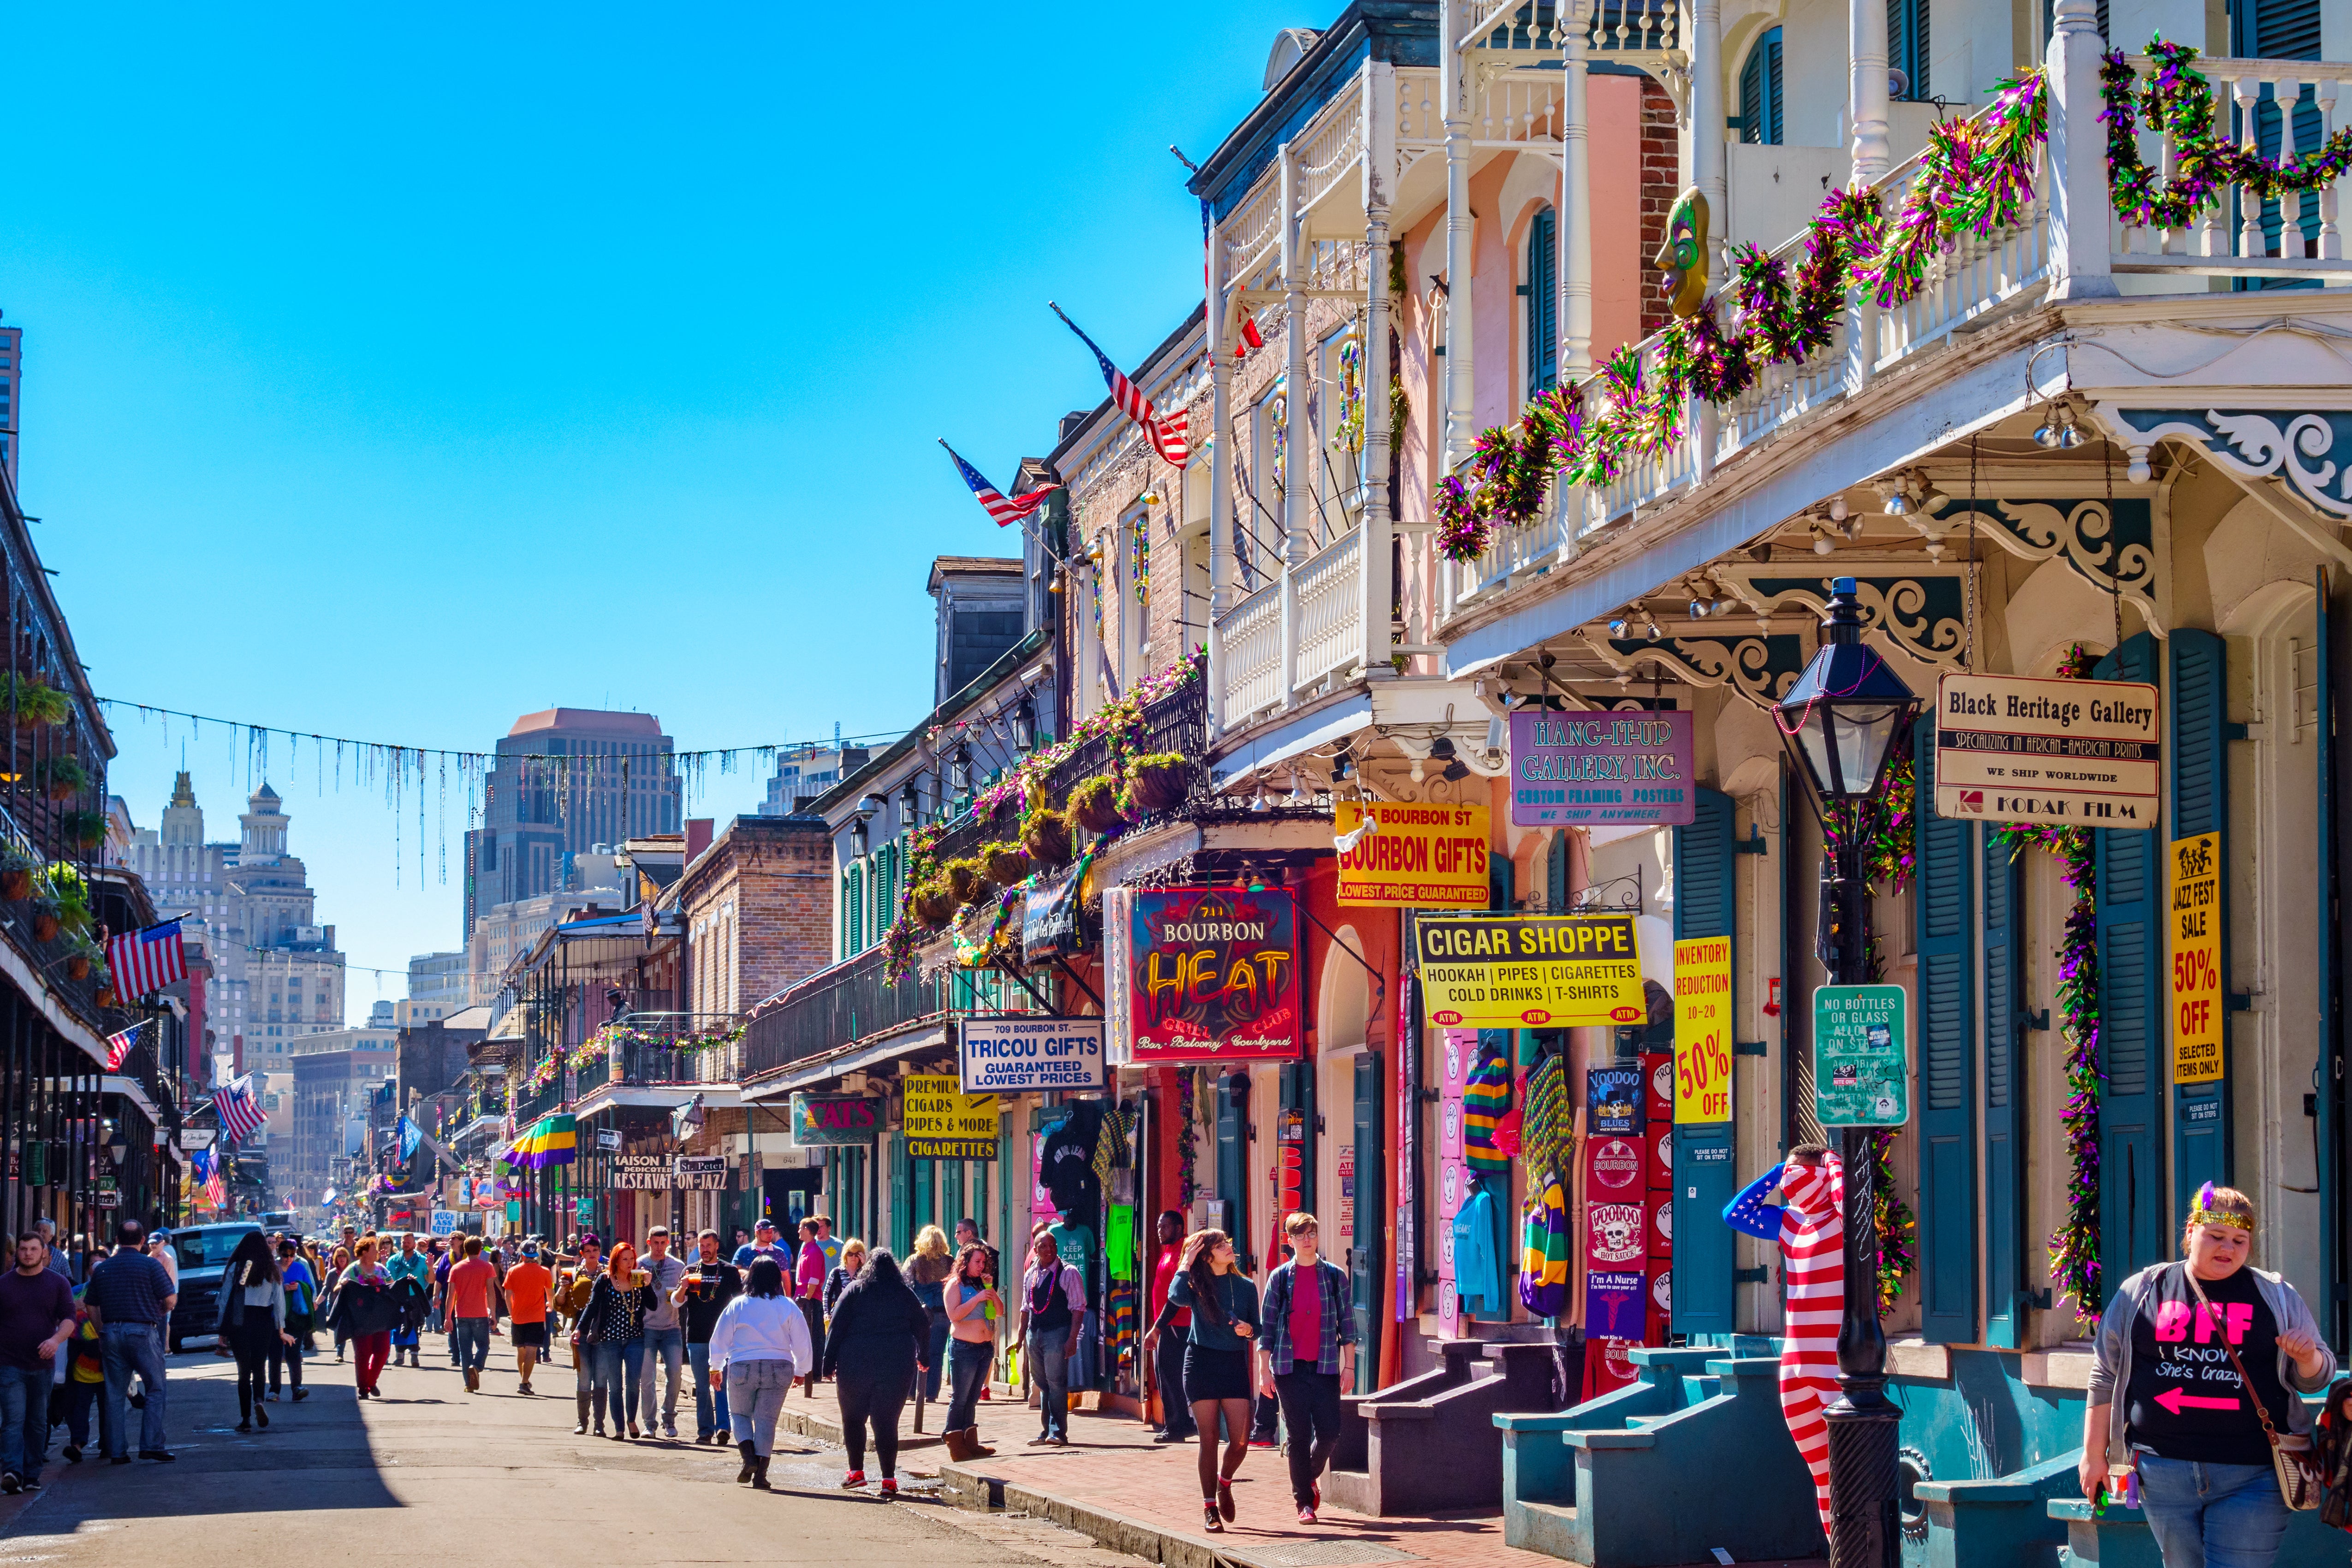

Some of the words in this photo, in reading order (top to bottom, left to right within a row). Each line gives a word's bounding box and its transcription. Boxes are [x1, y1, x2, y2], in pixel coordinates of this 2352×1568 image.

[1949, 692, 1997, 716] Black
[2007, 695, 2080, 727] Heritage
[2091, 700, 2152, 731] Gallery
[1534, 720, 1672, 746] HANG-IT-UP
[1956, 732, 2008, 751] SPECIALIZING
[2014, 736, 2021, 751] IN
[2027, 737, 2109, 757] AFRICAN-AMERICAN
[2115, 742, 2142, 758] PRINTS
[1520, 754, 1629, 783] GALLERY,
[1633, 754, 1681, 781] INC.
[1987, 767, 2004, 776] WE
[2012, 769, 2039, 778] SHIP
[2046, 771, 2118, 782] WORLDWIDE
[1518, 790, 1564, 804] CUSTOM
[1569, 790, 1621, 803] FRAMING
[1634, 789, 1683, 802] POSTERS
[1541, 811, 1556, 820] WE
[1565, 810, 1591, 819] SHIP
[1600, 809, 1661, 819] ANYWHERE
[1997, 797, 2071, 815] KODAK
[2084, 802, 2136, 819] FILM
[1382, 809, 1450, 825] BOURBON
[1455, 811, 1472, 826] ST
[1435, 837, 1485, 874] GIFTS
[1340, 884, 1380, 897] LOWEST
[1385, 885, 1415, 899] PRICE
[1418, 887, 1486, 902] GUARANTEED
[2174, 884, 2191, 912] JAZZ
[2194, 879, 2215, 906] FEST
[1200, 907, 1224, 917] 711
[1163, 922, 1264, 942] BOURBON
[2181, 911, 2206, 940] SALE
[1427, 929, 1511, 956] CIGAR
[1520, 926, 1629, 954] SHOPPE
[1676, 943, 1727, 965] INVENTORY
[1428, 968, 1485, 982] HOOKAH
[1499, 968, 1538, 981] PIPES
[1551, 965, 1636, 980] CIGARETTES
[2174, 947, 2216, 993] 50%
[1147, 950, 1289, 1023] HEAT
[1449, 988, 1485, 1002] COLD
[1491, 987, 1542, 1002] DRINKS
[1558, 985, 1619, 1000] T-SHIRTS
[1676, 974, 1728, 996] REDUCTION
[1688, 1005, 1715, 1019] 10-20
[1825, 999, 1840, 1010] NO
[1846, 998, 1895, 1009] BOTTLES
[1163, 1018, 1211, 1039] GRILL
[1252, 1008, 1291, 1033] CLUB
[1438, 1013, 1458, 1023] ATM
[1526, 1011, 1546, 1022] ATM
[1616, 1009, 1635, 1020] ATM
[1832, 1012, 1845, 1023] OR
[1852, 1012, 1889, 1023] GLASS
[2180, 999, 2209, 1036] OFF
[1014, 1024, 1055, 1033] BOURBON
[1058, 1024, 1071, 1032] ST.
[968, 1039, 1037, 1058] TRICOU
[1045, 1037, 1098, 1056] GIFTS
[1136, 1036, 1163, 1050] Bar
[1170, 1035, 1224, 1051] Balcony
[1230, 1035, 1292, 1050] Courtyard
[1829, 1039, 1843, 1049] ON
[2179, 1043, 2215, 1061] SELECTED
[985, 1062, 1081, 1074] GUARANTEED
[1452, 1063, 1455, 1074] 2
[1677, 1030, 1728, 1100] 50%
[2177, 1063, 2197, 1078] ITEMS
[2199, 1059, 2219, 1075] ONLY
[907, 1080, 960, 1094] PREMIUM
[976, 1074, 1033, 1086] LOWEST
[1039, 1072, 1092, 1083] PRICES
[1589, 1071, 1639, 1087] VOODOO
[907, 1099, 952, 1112] CIGARS
[1703, 1093, 1728, 1116] OFF
[808, 1101, 874, 1129] CATS
[906, 1117, 942, 1132] PIPES
[947, 1120, 954, 1131] &
[958, 1119, 993, 1132] MORE
[909, 1141, 994, 1157] CIGARETTES
[1594, 1160, 1638, 1170] BOURBON
[608, 1173, 693, 1189] RESERVATON
[699, 1170, 728, 1189] JAZZ
[1592, 1206, 1640, 1226] VOODOO
[433, 1226, 456, 1234] BEERS
[1447, 1245, 1451, 1257] 2
[1615, 1251, 1634, 1260] SAUCE
[1592, 1275, 1604, 1283] I'm
[1606, 1275, 1612, 1283] A
[1615, 1275, 1638, 1284] Nurse
[1447, 1302, 1450, 1313] 3
[2156, 1301, 2253, 1344] BFF
[2174, 1346, 2243, 1362] KNOW
[2156, 1362, 2193, 1378] She's
